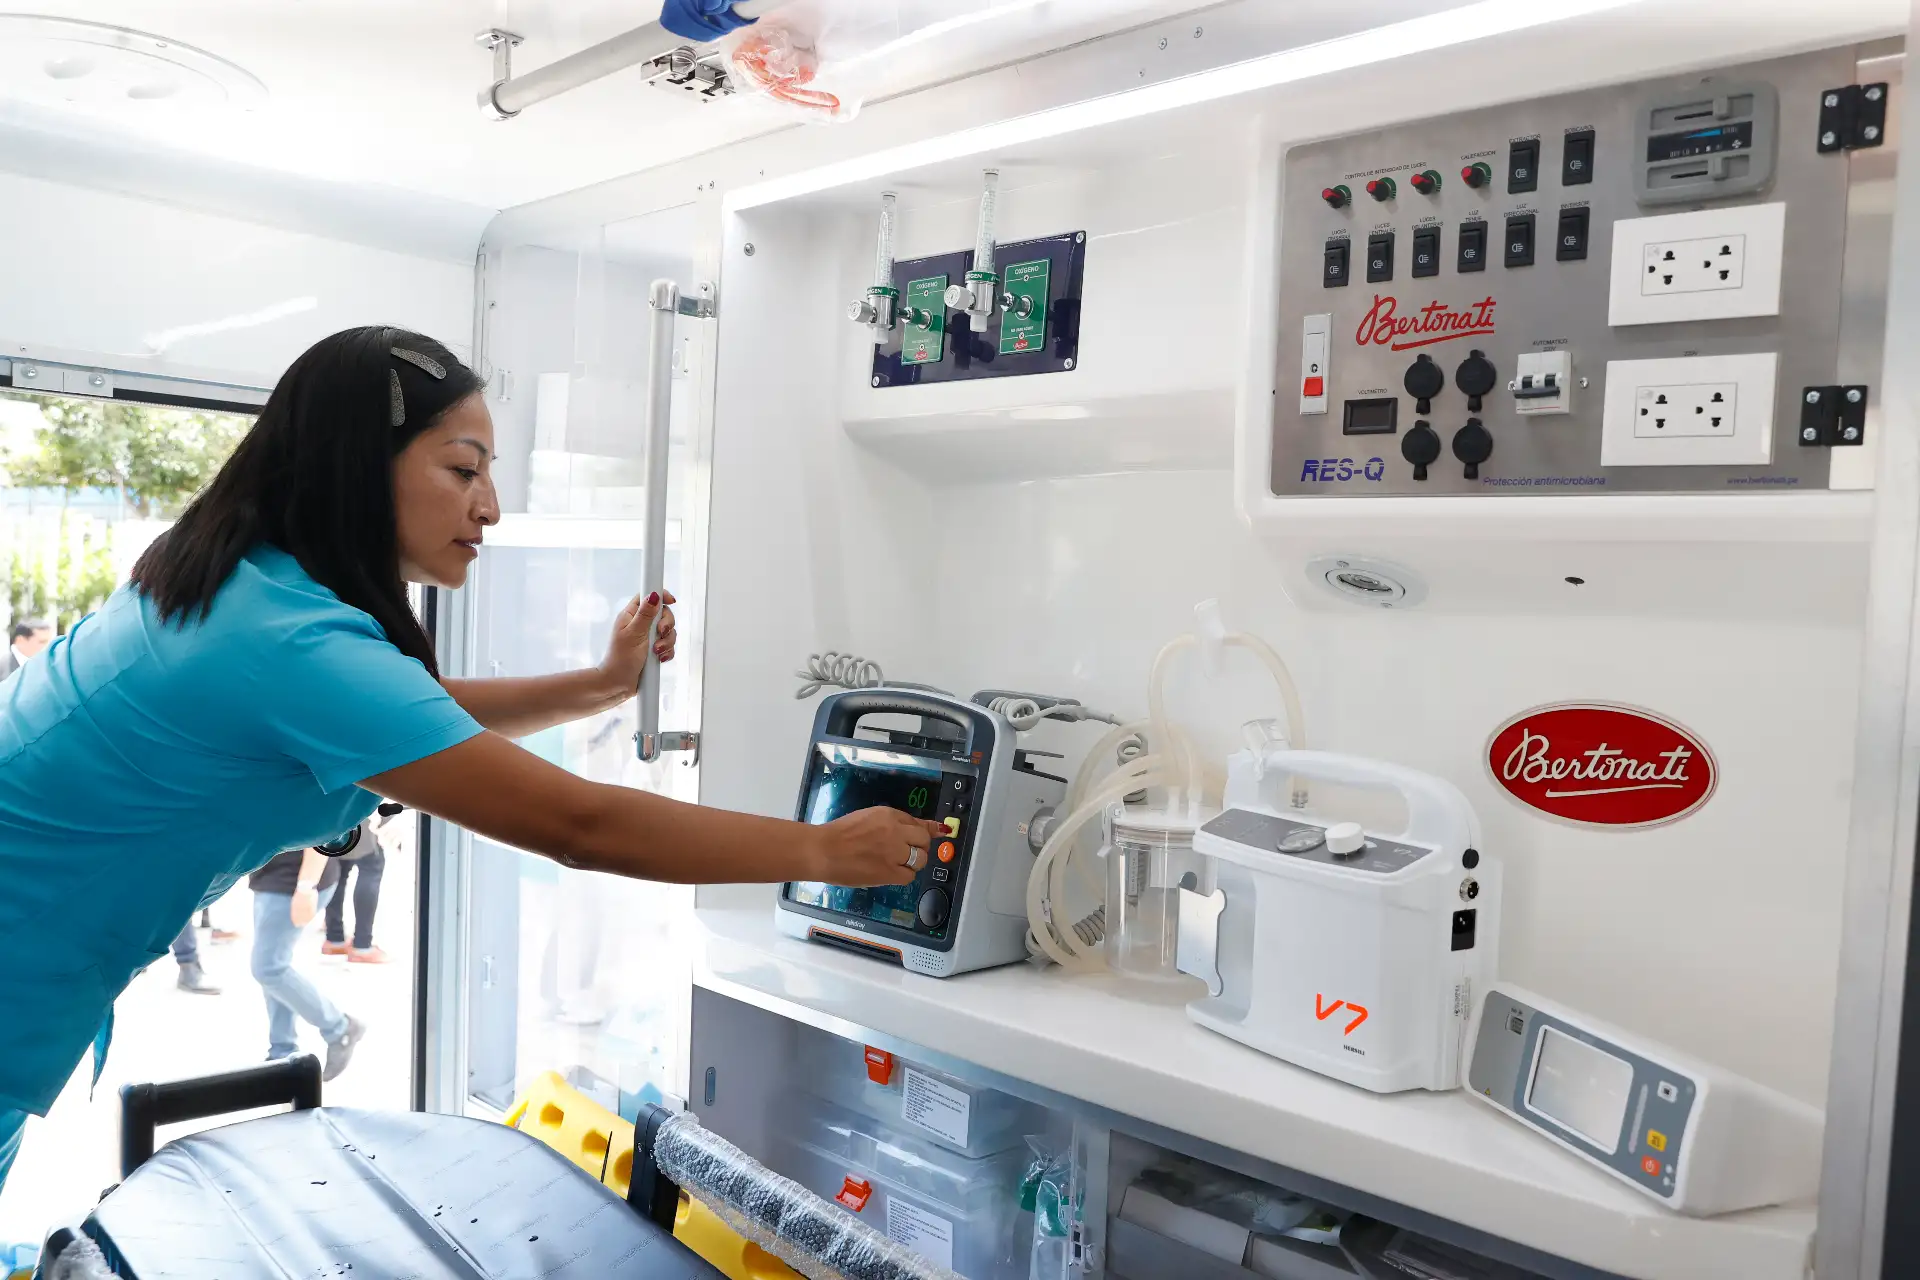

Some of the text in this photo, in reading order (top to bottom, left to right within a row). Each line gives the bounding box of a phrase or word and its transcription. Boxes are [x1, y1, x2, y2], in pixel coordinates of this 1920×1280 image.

[1355, 294, 1497, 347] Bertonati
[1300, 456, 1385, 482] RES-Q
[1483, 476, 1606, 487] Protección antimicrobiana
[1503, 728, 1692, 787] Bertonati
[908, 787, 928, 808] 60
[1315, 992, 1369, 1037] V7
